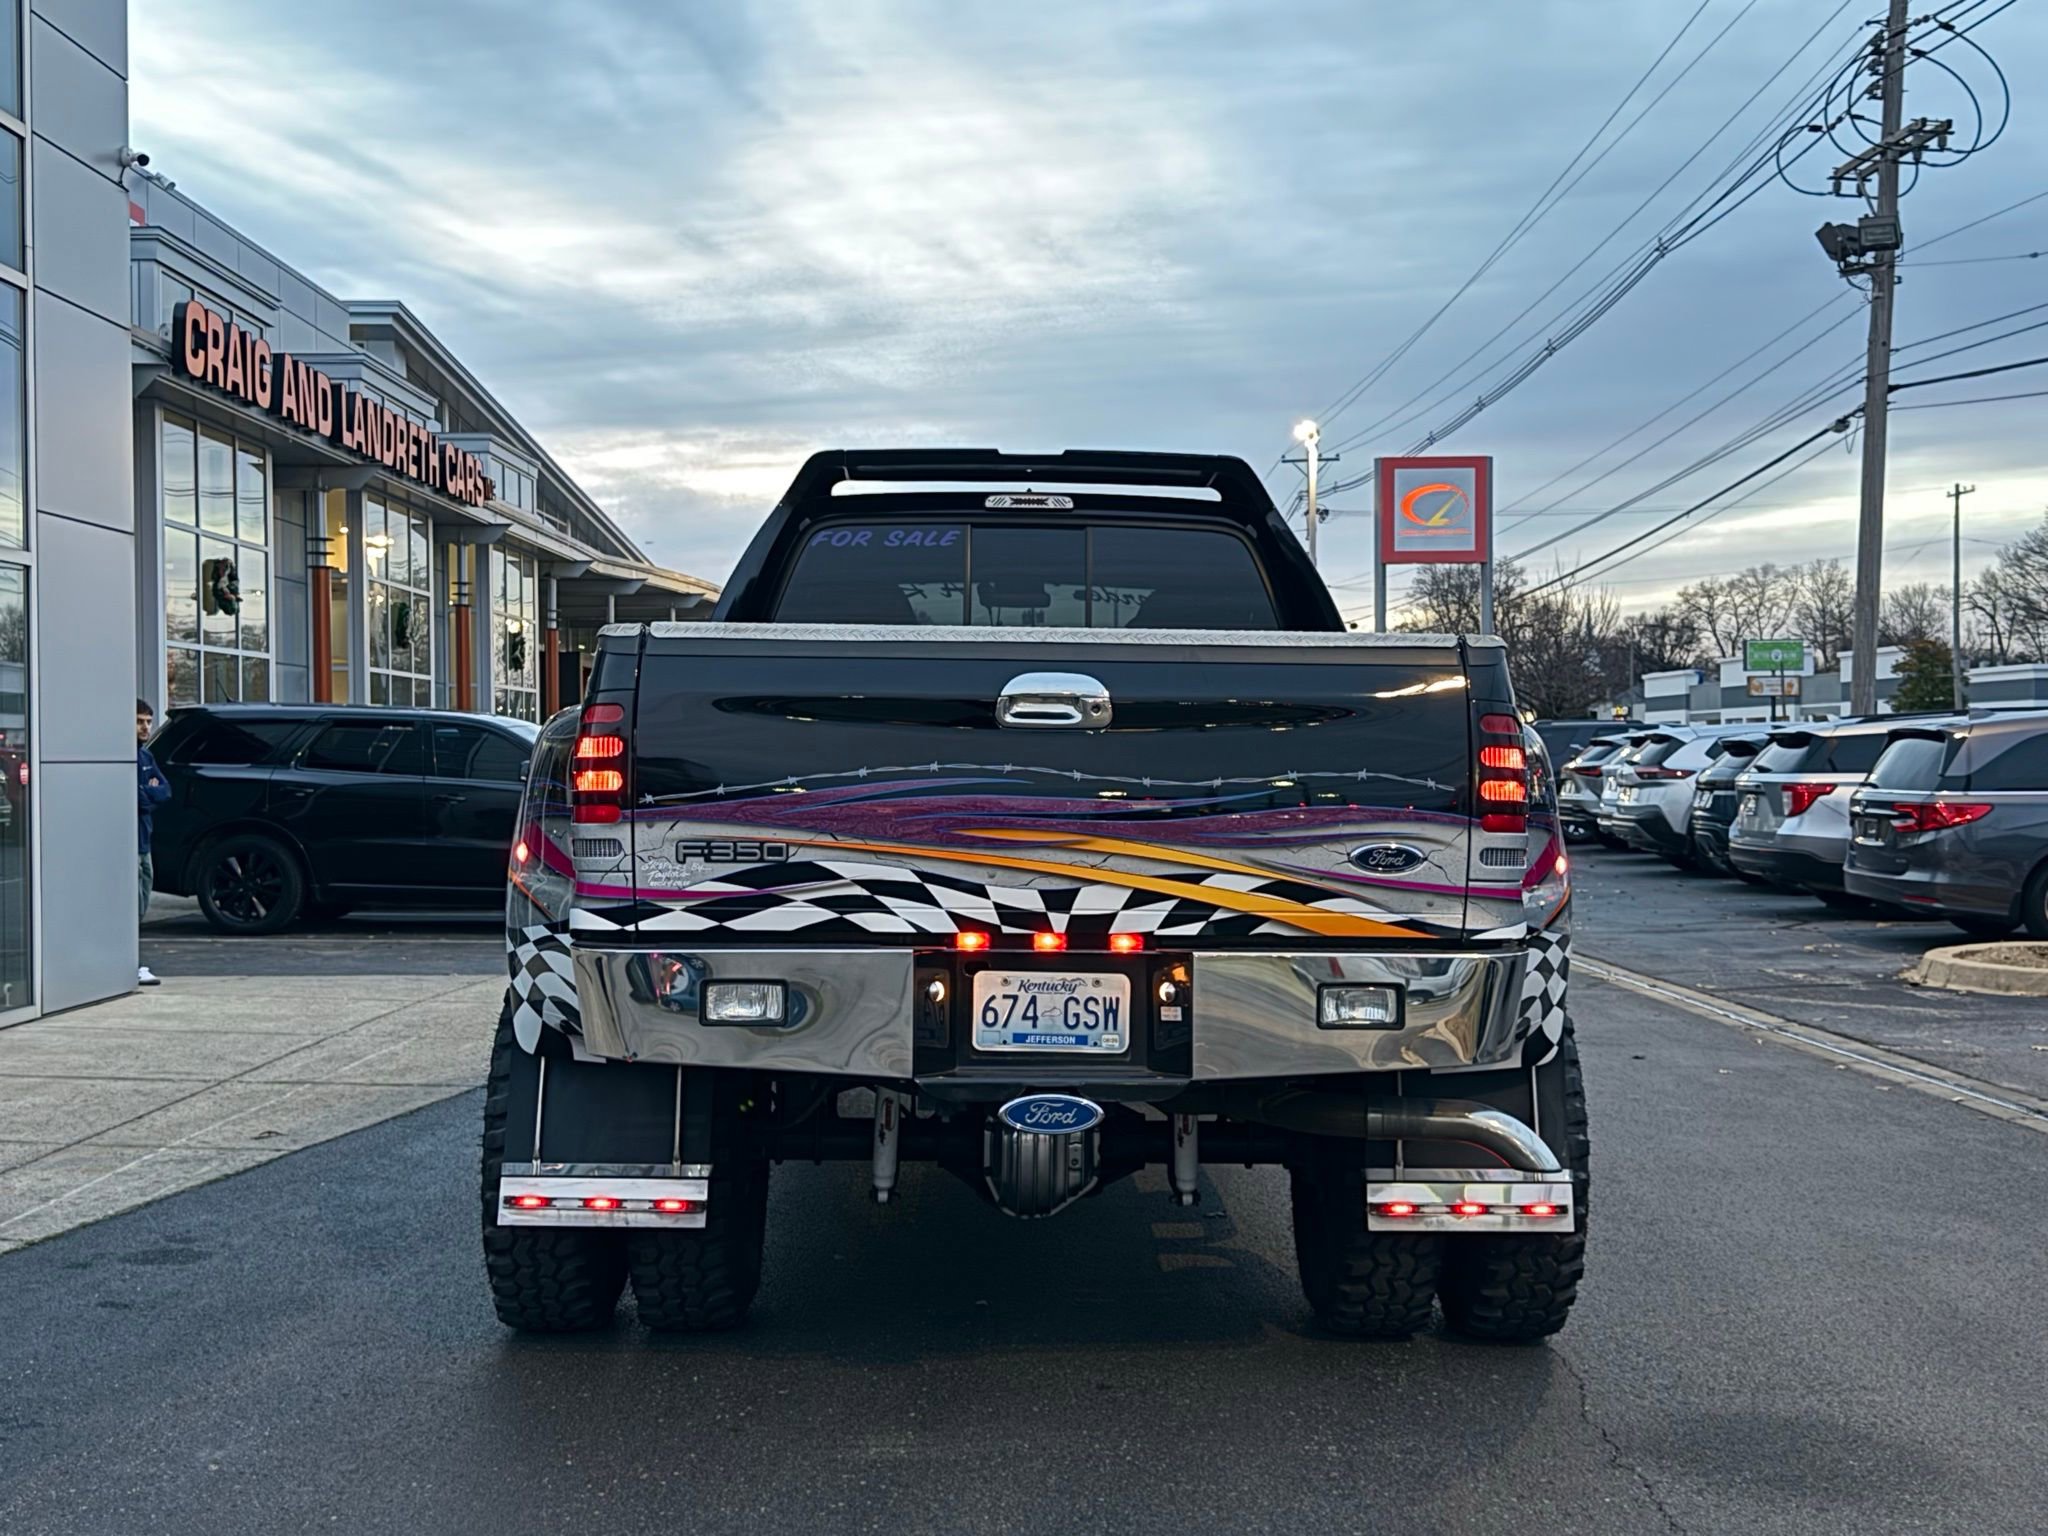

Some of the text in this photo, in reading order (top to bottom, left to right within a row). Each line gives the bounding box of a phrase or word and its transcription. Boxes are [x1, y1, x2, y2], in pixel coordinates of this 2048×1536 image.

[184, 299, 485, 508] CRAIG AND LANDRETH CARS
[811, 530, 961, 547] FOR SALE
[1368, 849, 1406, 866] Ford
[1017, 978, 1078, 995] Kentucky
[981, 994, 1120, 1031] 674 GSW
[1025, 1034, 1076, 1044] JEFFERSON
[1025, 1102, 1078, 1124] Ford
